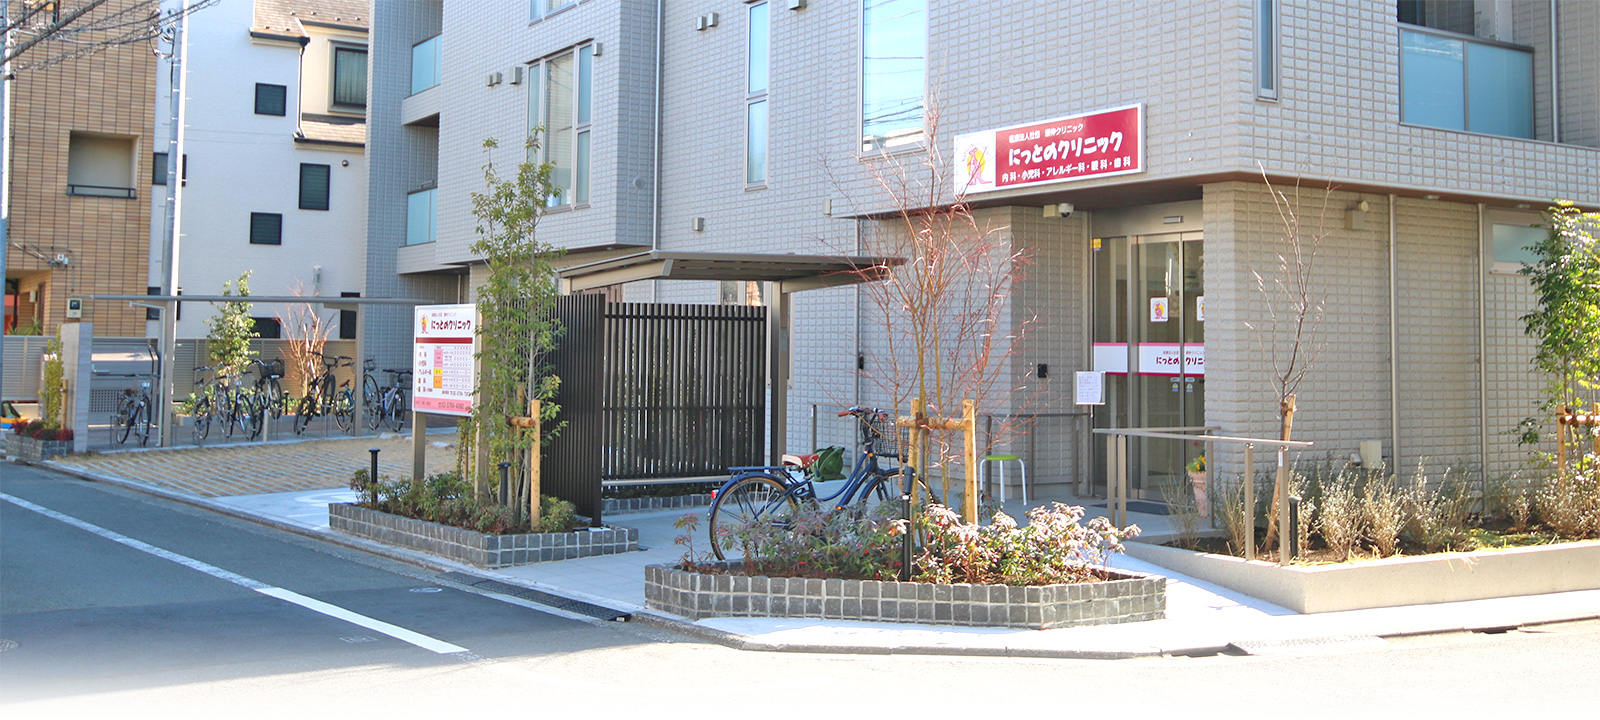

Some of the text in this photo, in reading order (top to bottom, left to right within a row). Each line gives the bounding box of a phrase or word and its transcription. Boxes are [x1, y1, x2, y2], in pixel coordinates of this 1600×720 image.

[1008, 131, 1123, 166] にっとのクリニック
[1185, 357, 1205, 365] クリニ
